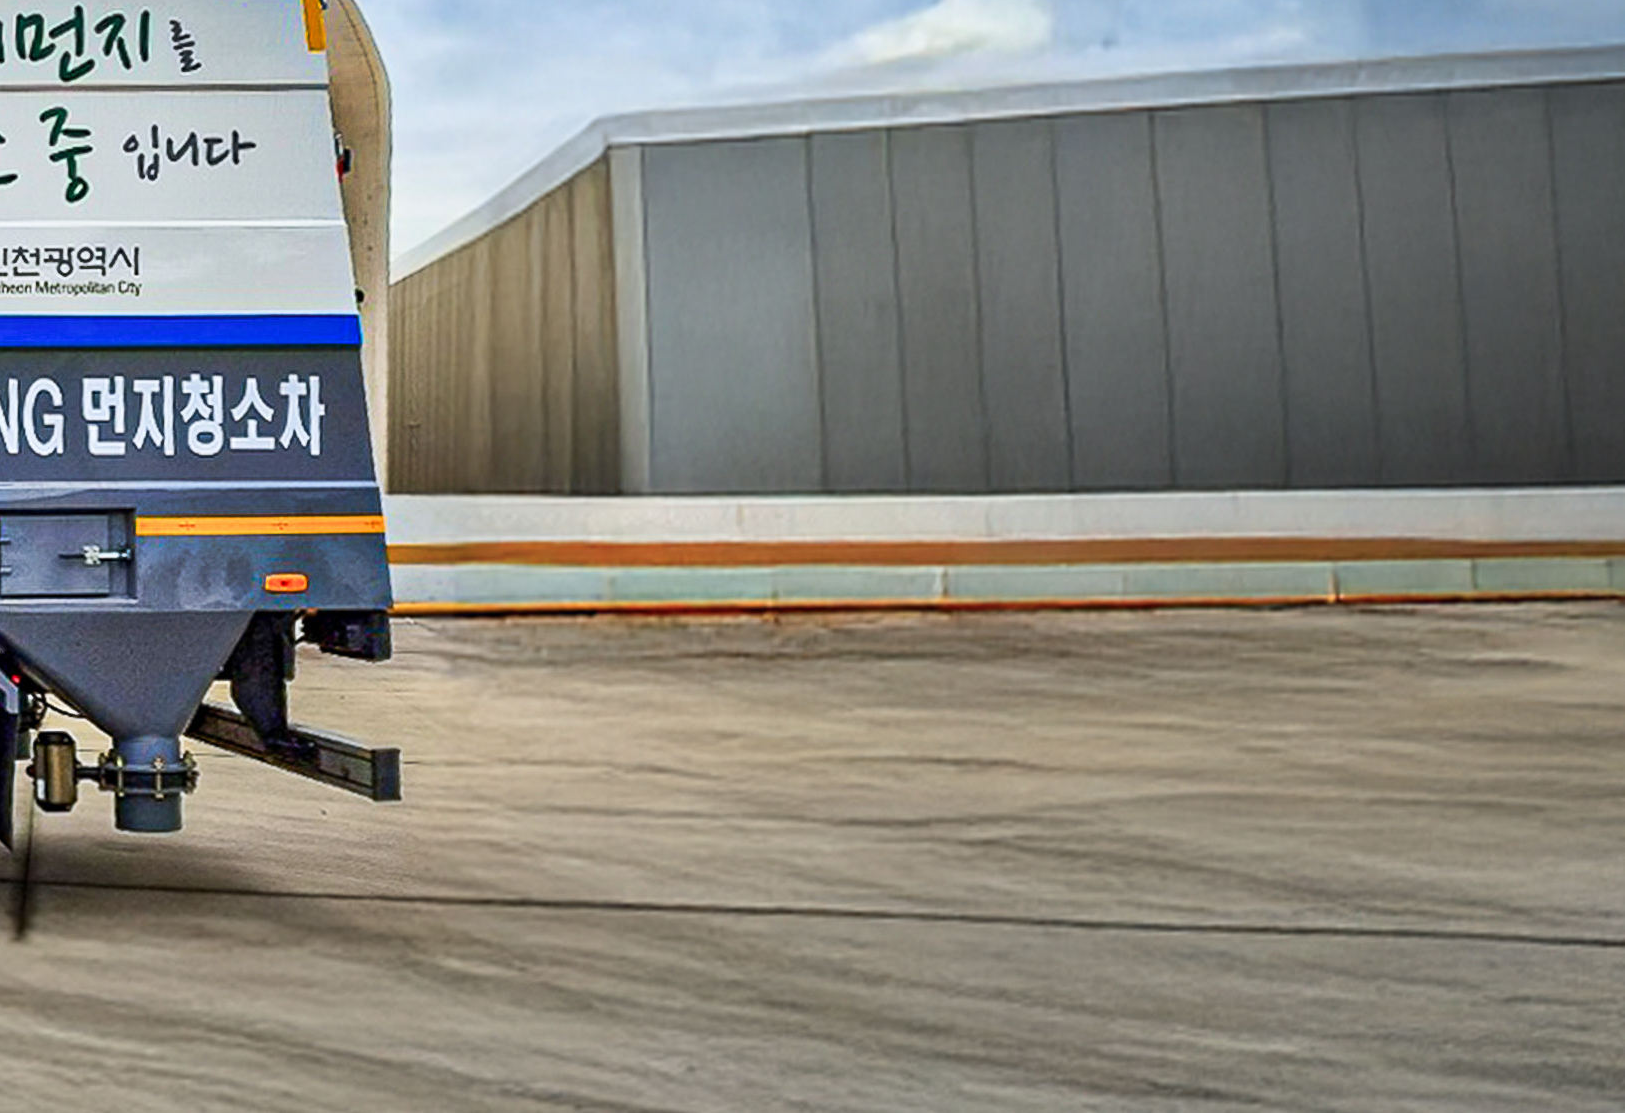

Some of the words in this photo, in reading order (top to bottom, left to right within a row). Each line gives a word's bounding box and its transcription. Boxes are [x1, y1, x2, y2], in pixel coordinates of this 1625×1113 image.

[169, 20, 202, 72] 를
[40, 106, 93, 202] 중
[123, 124, 256, 180] 입니다
[35, 281, 115, 296] Metropolitan
[118, 280, 142, 296] City
[82, 373, 325, 457] 먼지청소차
